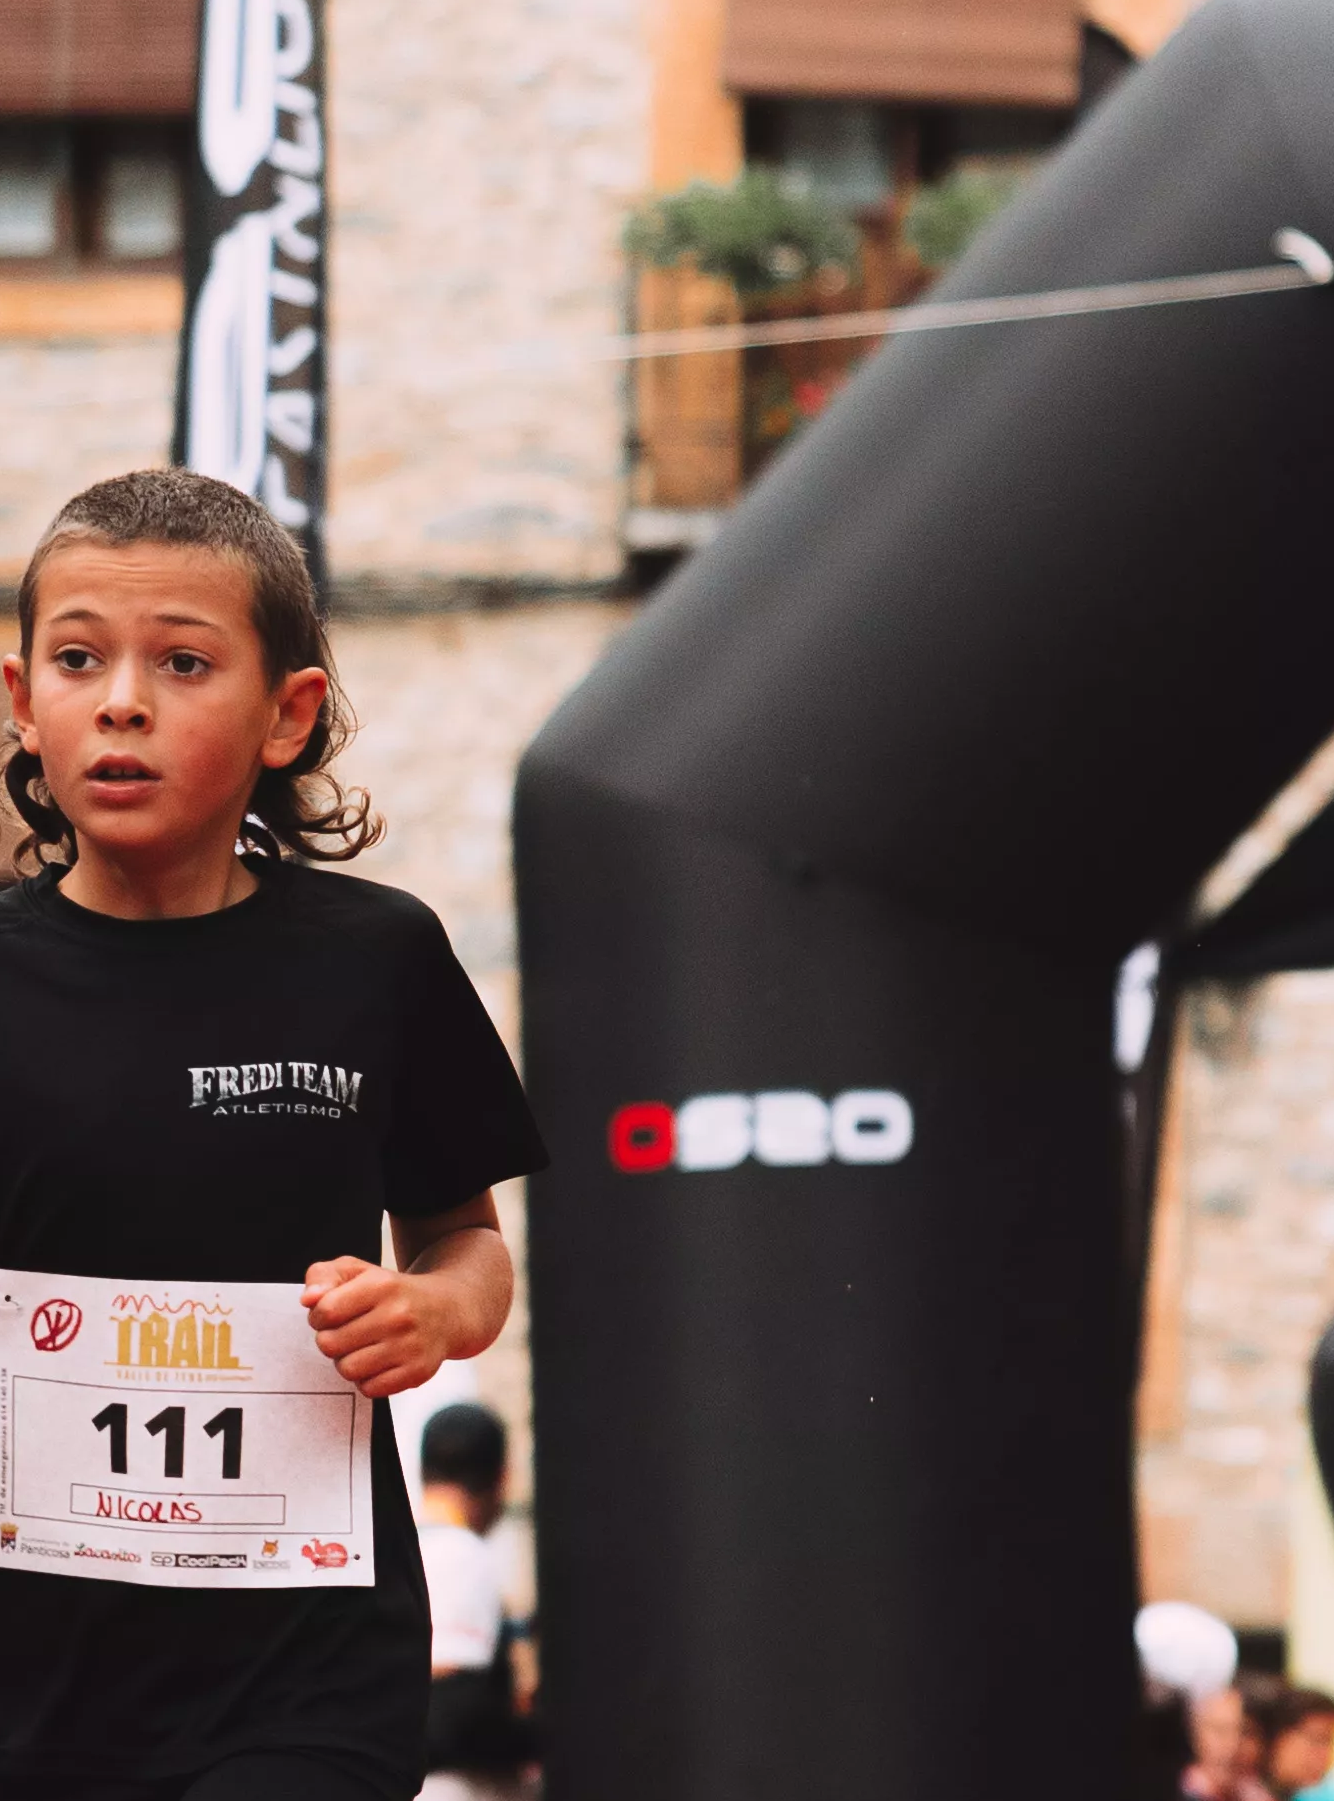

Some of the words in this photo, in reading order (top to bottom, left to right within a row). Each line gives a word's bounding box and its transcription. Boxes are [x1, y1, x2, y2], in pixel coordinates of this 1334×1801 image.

[188, 1062, 283, 1108] FREDI
[288, 1061, 363, 1112] TEAM
[212, 1102, 341, 1118] ATLETISMO
[112, 1292, 233, 1315] mini
[109, 1311, 240, 1368] TRAIL
[91, 1402, 243, 1479] 111
